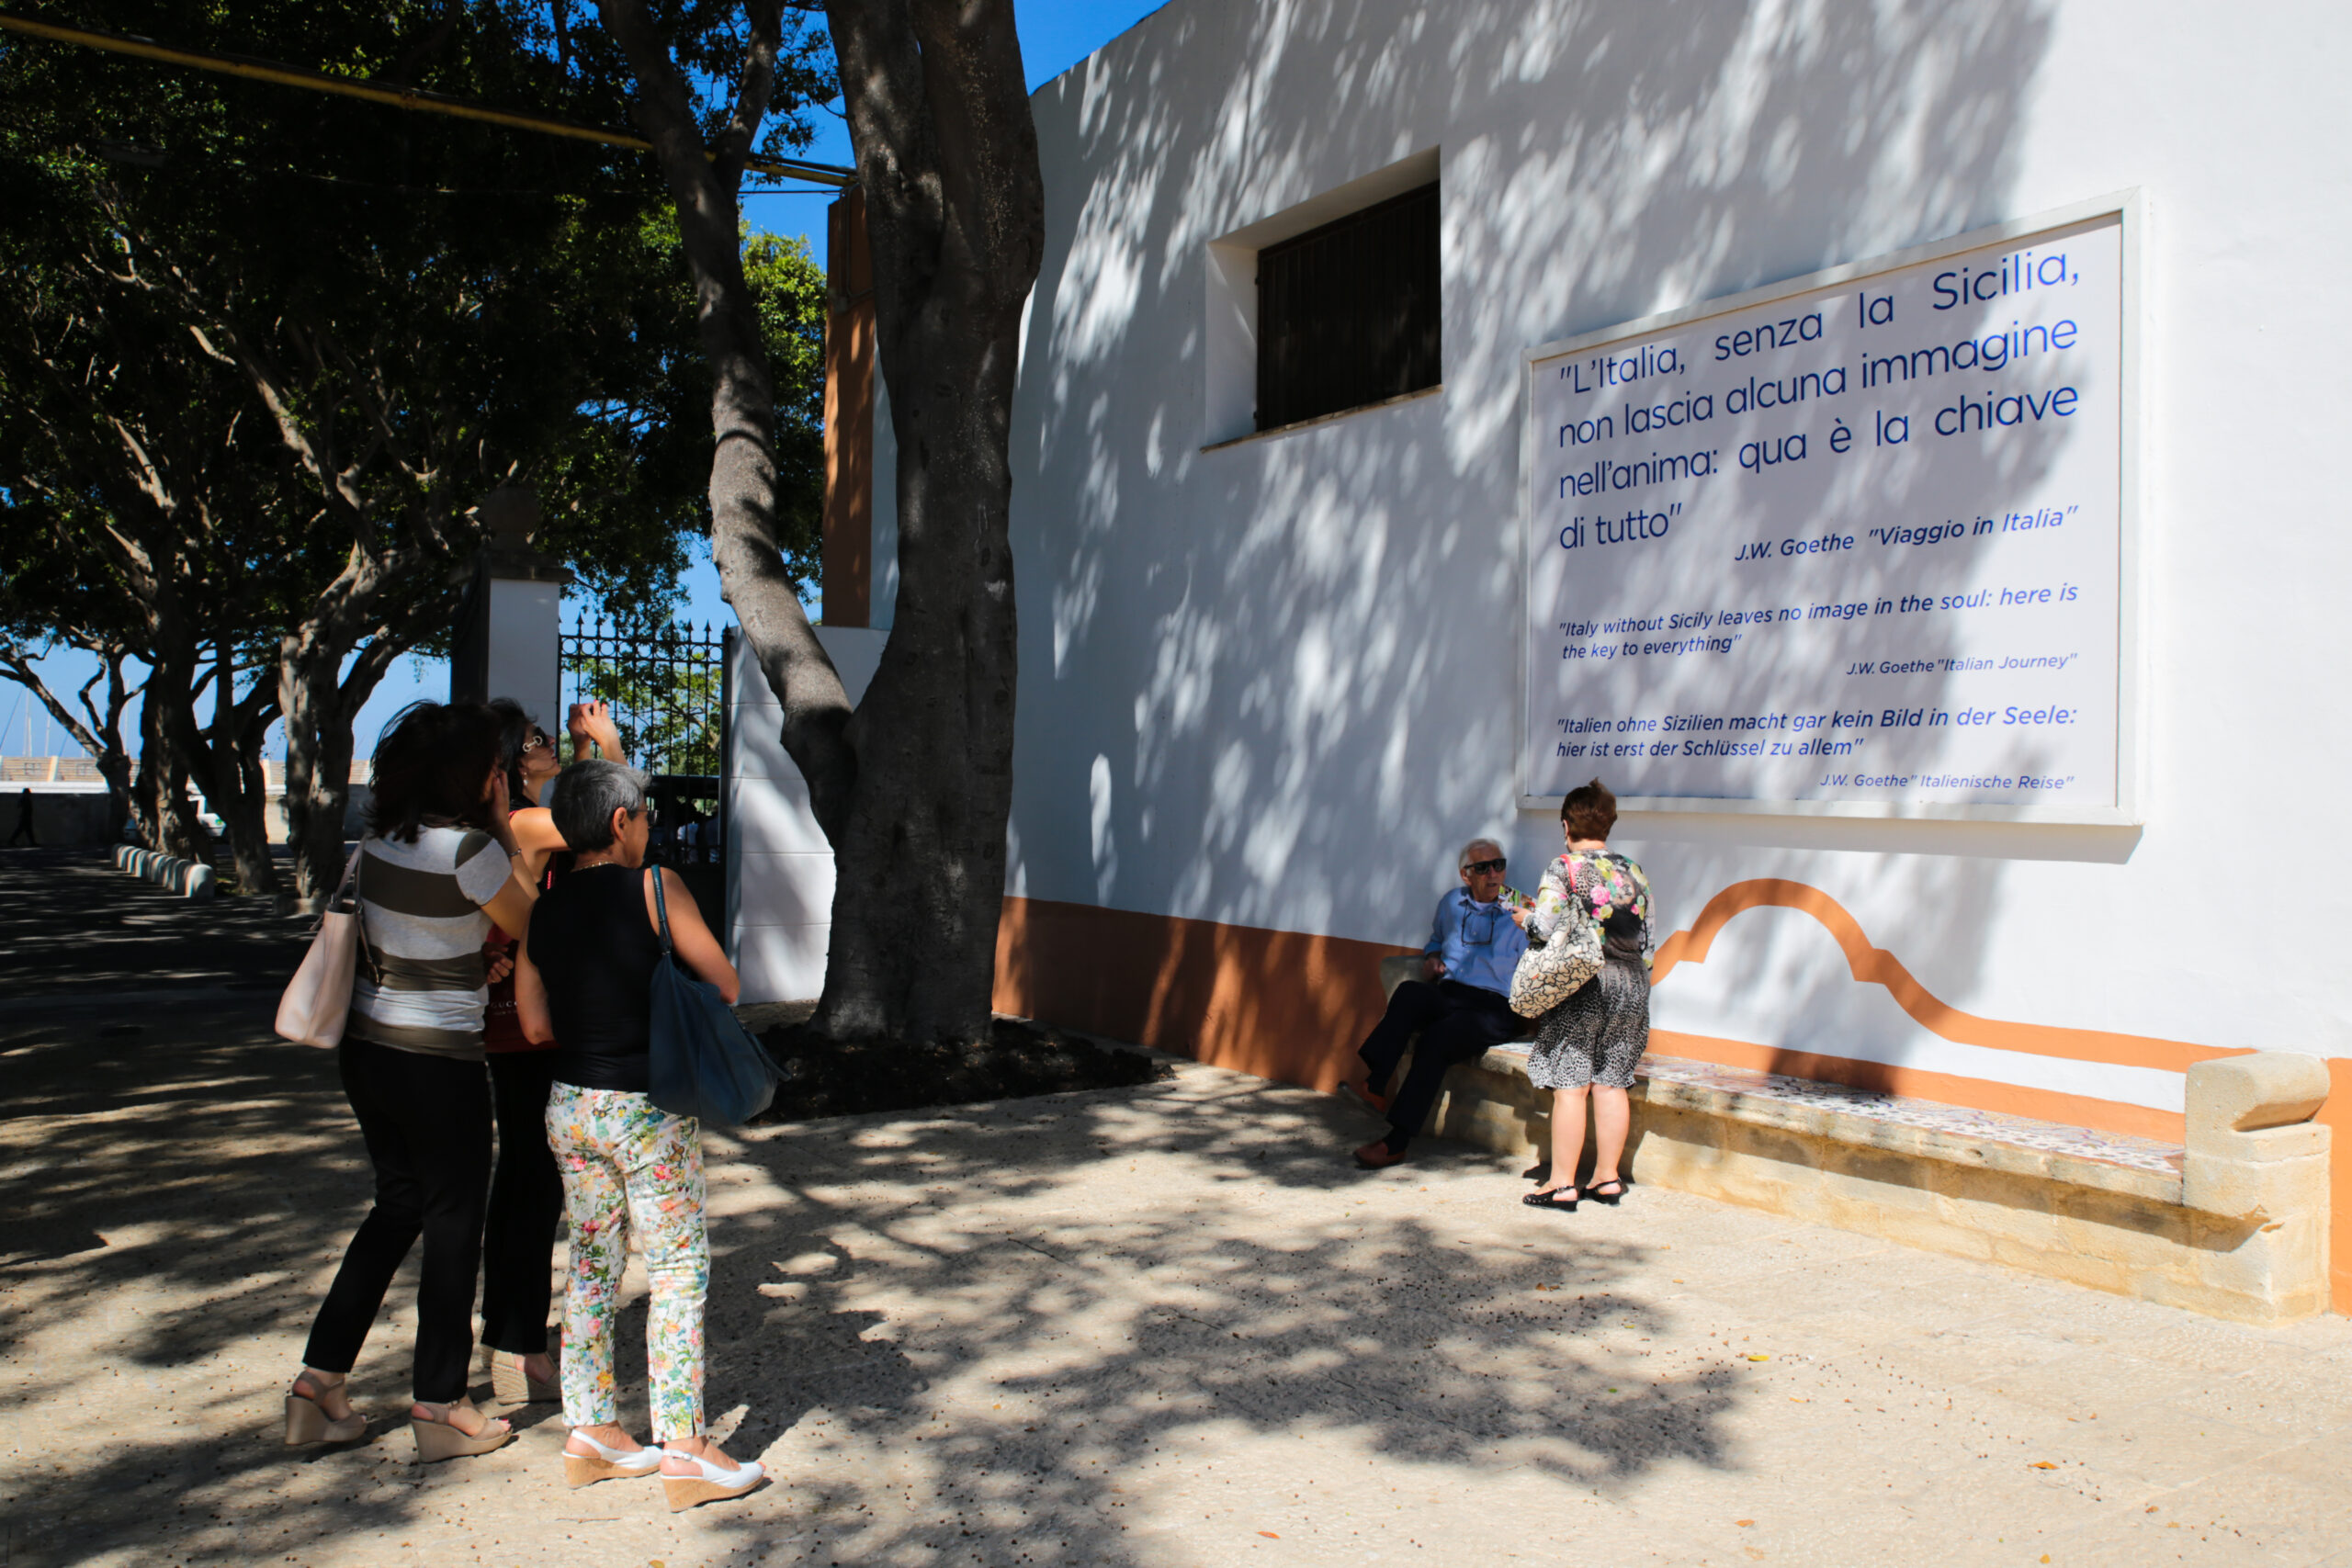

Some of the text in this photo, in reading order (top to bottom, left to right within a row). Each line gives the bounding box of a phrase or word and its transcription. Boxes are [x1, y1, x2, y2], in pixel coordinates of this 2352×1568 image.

[1714, 313, 1823, 361] senza
[1859, 293, 1894, 328] la
[1932, 253, 2078, 310] Sicilia,
[1559, 321, 2078, 447] non lascia alcuna immagine
[1738, 434, 1806, 474] qua
[1829, 418, 1852, 453] è
[1876, 411, 1909, 446] la
[1934, 388, 2079, 436] chiave
[1559, 503, 1682, 549] di tutto"
[1734, 506, 2078, 561] J.W. Goethe "Viaggio in Italia"
[1559, 581, 2079, 638] "Italy without Sicily leaves no image in the soul: here is
[1562, 633, 1743, 660] the key to everything"
[1846, 661, 1875, 676] J.W.
[1879, 659, 1936, 674] Goethe
[1998, 653, 2078, 670] Journey"
[1557, 705, 2077, 734] "Italien ohne Sizilien macht gar kein Bild in der Seele:
[1556, 737, 1865, 758] hier ist erst der Schlüssel zu allem"
[1820, 773, 1849, 786] J.W.
[2018, 775, 2075, 789] Reise"
